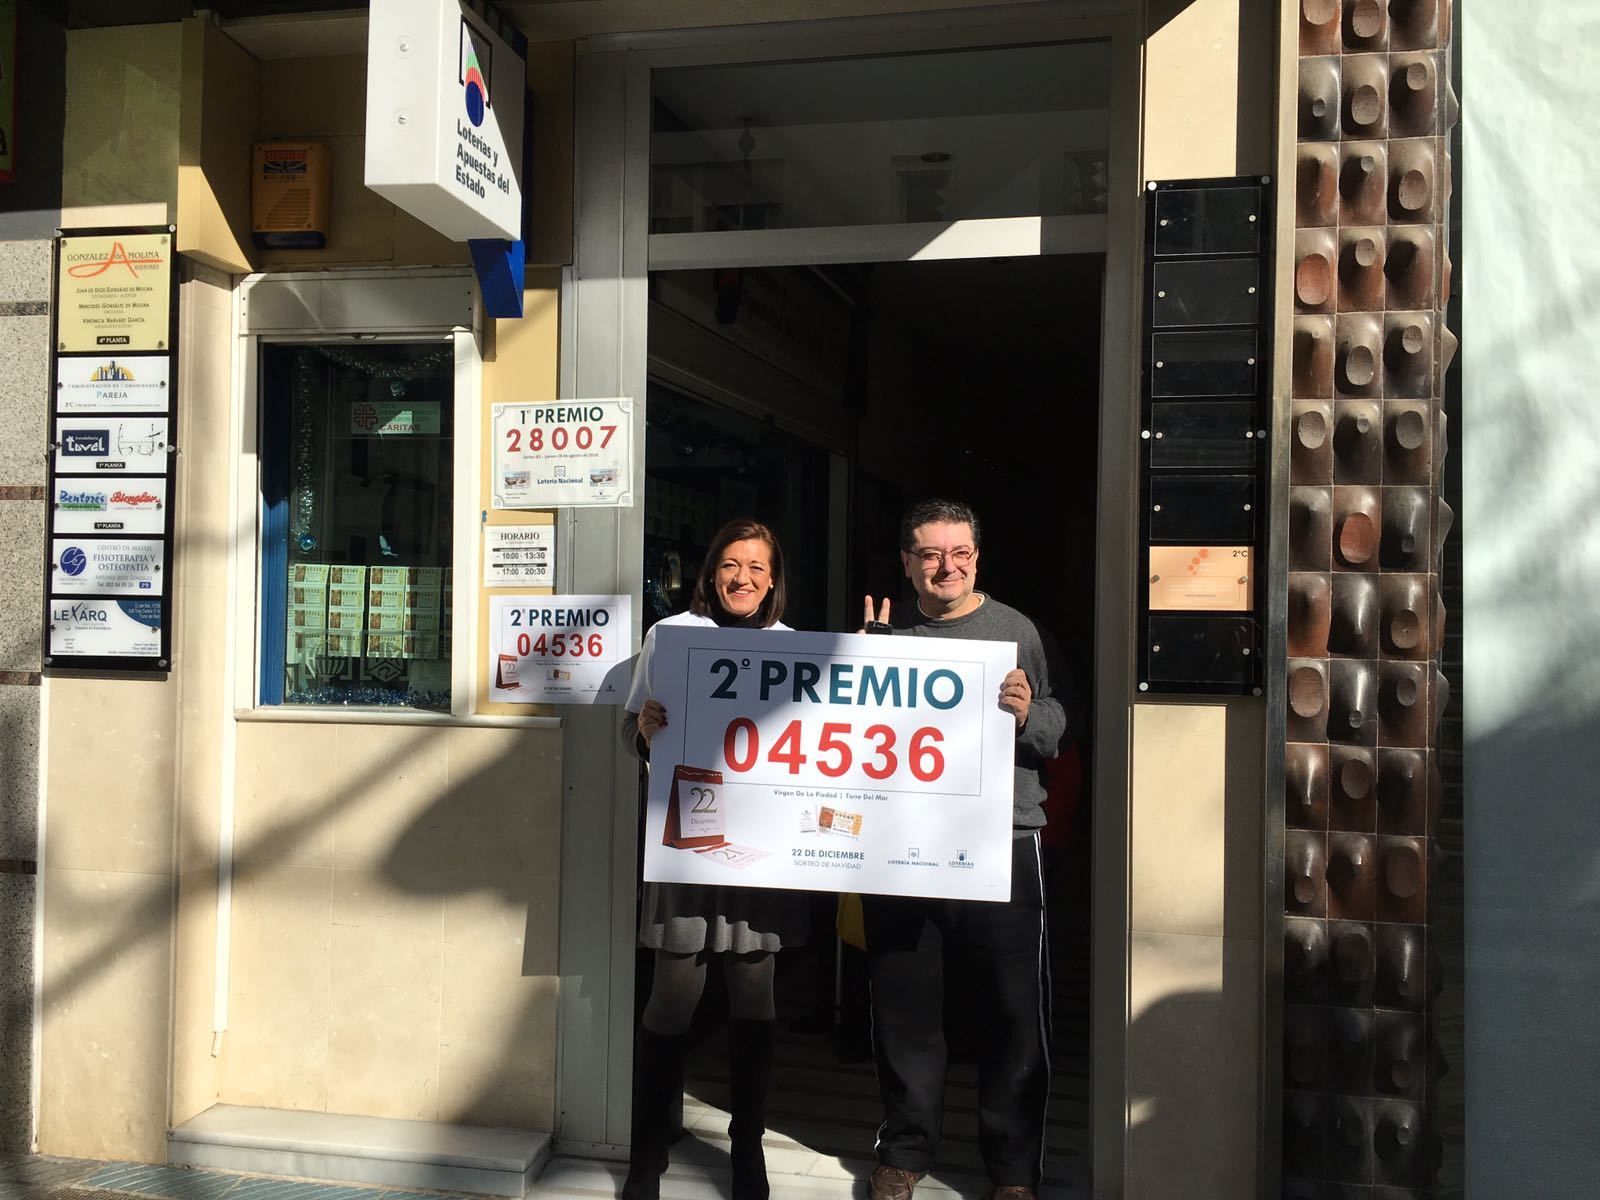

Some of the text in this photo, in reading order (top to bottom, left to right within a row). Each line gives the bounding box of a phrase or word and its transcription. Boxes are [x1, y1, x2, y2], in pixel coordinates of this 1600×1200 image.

[493, 150, 498, 168] y
[457, 143, 510, 195] Apuestas del
[456, 164, 486, 199] Estado
[128, 251, 160, 259] MOLINA
[96, 391, 128, 399] PAREJA
[535, 406, 603, 424] PREMIO
[506, 425, 618, 452] 28007
[500, 532, 540, 540] HORARIO
[94, 554, 148, 562] FISIOTERAPIA
[98, 562, 149, 572] OSTEOPATÍA
[529, 608, 609, 626] PREMIO
[517, 633, 603, 657] 04536
[710, 658, 964, 710] 2º PREMIO
[724, 717, 945, 782] 04536
[690, 787, 717, 813] 22
[774, 789, 794, 797] Virgen
[819, 850, 864, 860] DICIEMBRE
